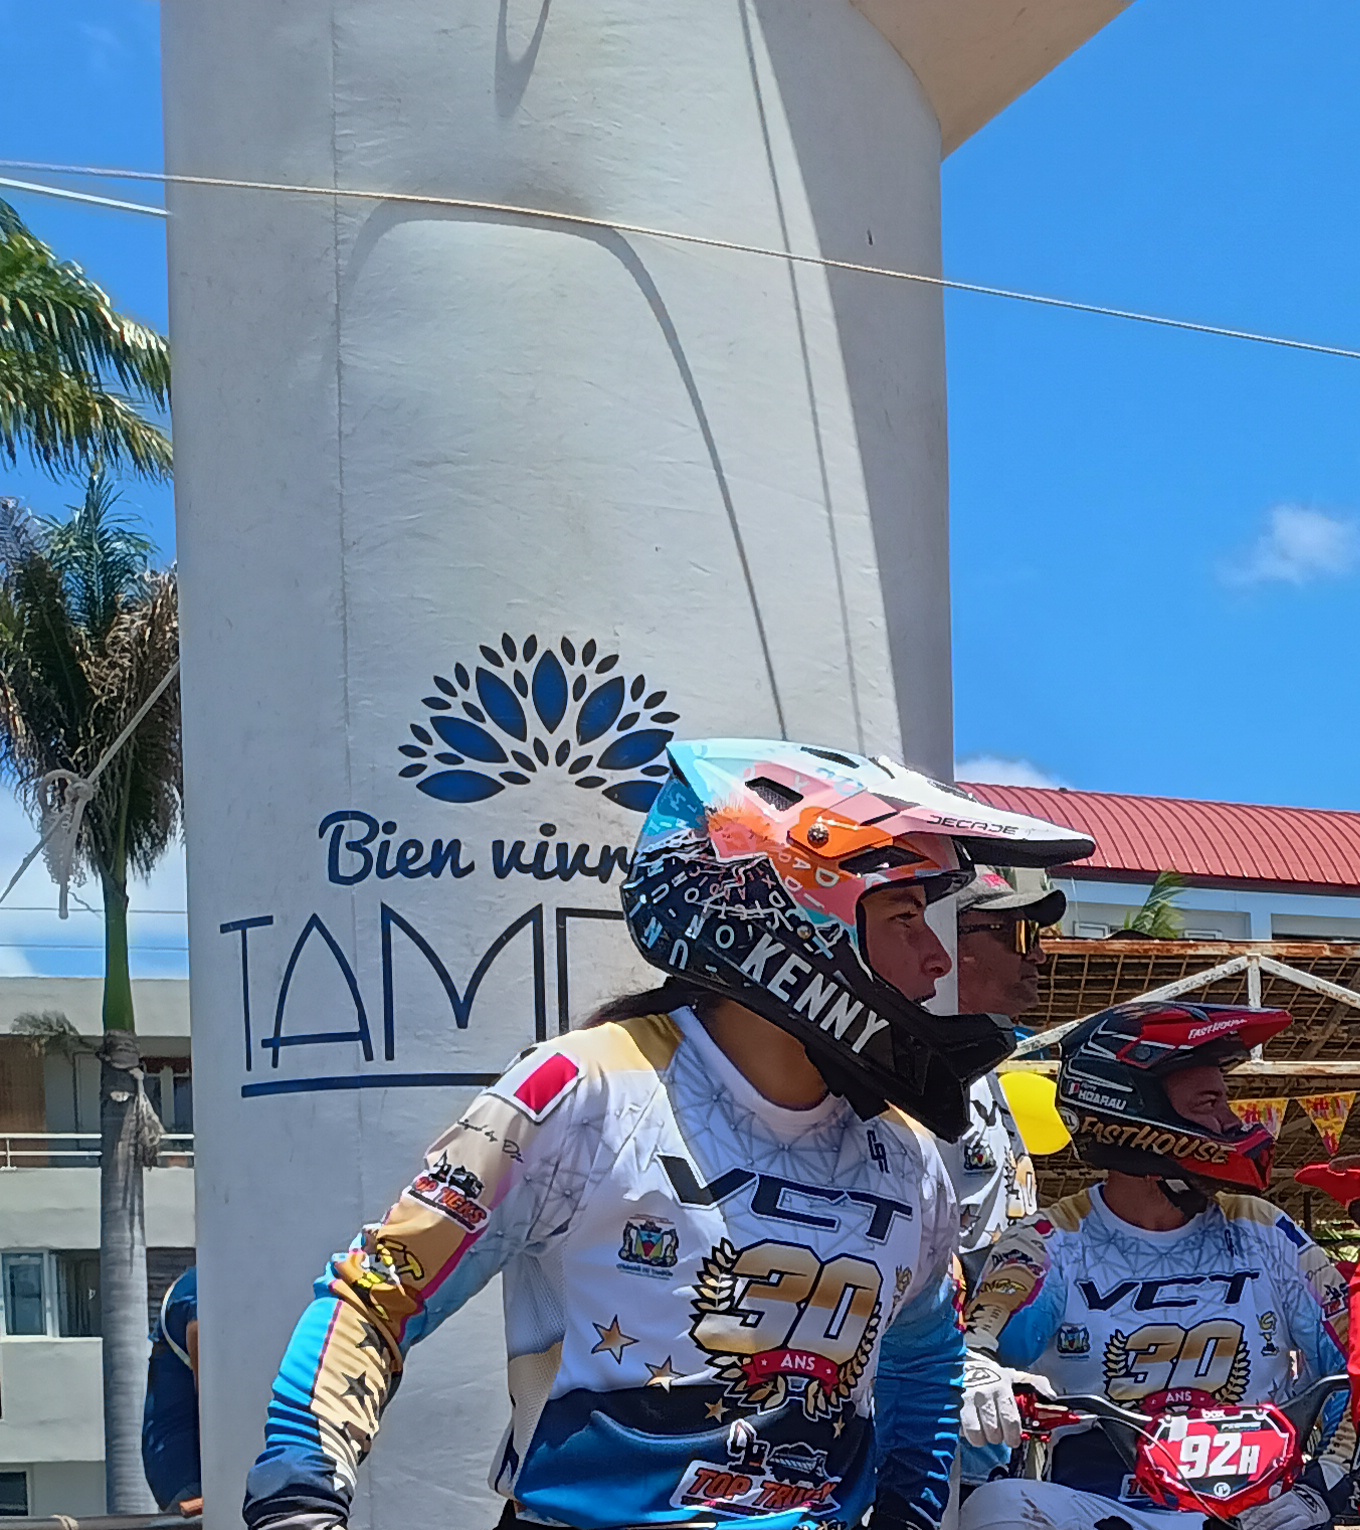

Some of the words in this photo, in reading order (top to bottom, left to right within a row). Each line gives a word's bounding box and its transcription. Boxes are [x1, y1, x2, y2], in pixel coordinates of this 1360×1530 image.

[318, 809, 476, 886] Bien
[491, 822, 632, 883] vivr
[926, 813, 1021, 837] DECADE
[740, 932, 891, 1054] KENNY
[1077, 1089, 1127, 1111] HOARAU
[1079, 1114, 1231, 1165] FASTHOUSE
[654, 1153, 914, 1245] VCT
[689, 1238, 884, 1365] 30
[1075, 1268, 1260, 1312] VCT
[780, 1354, 816, 1371] ANS
[1104, 1318, 1245, 1402] 30
[1165, 1390, 1193, 1402] ANS
[1201, 1406, 1227, 1420] box
[1178, 1430, 1262, 1481] 92H
[686, 1467, 752, 1500] TOP
